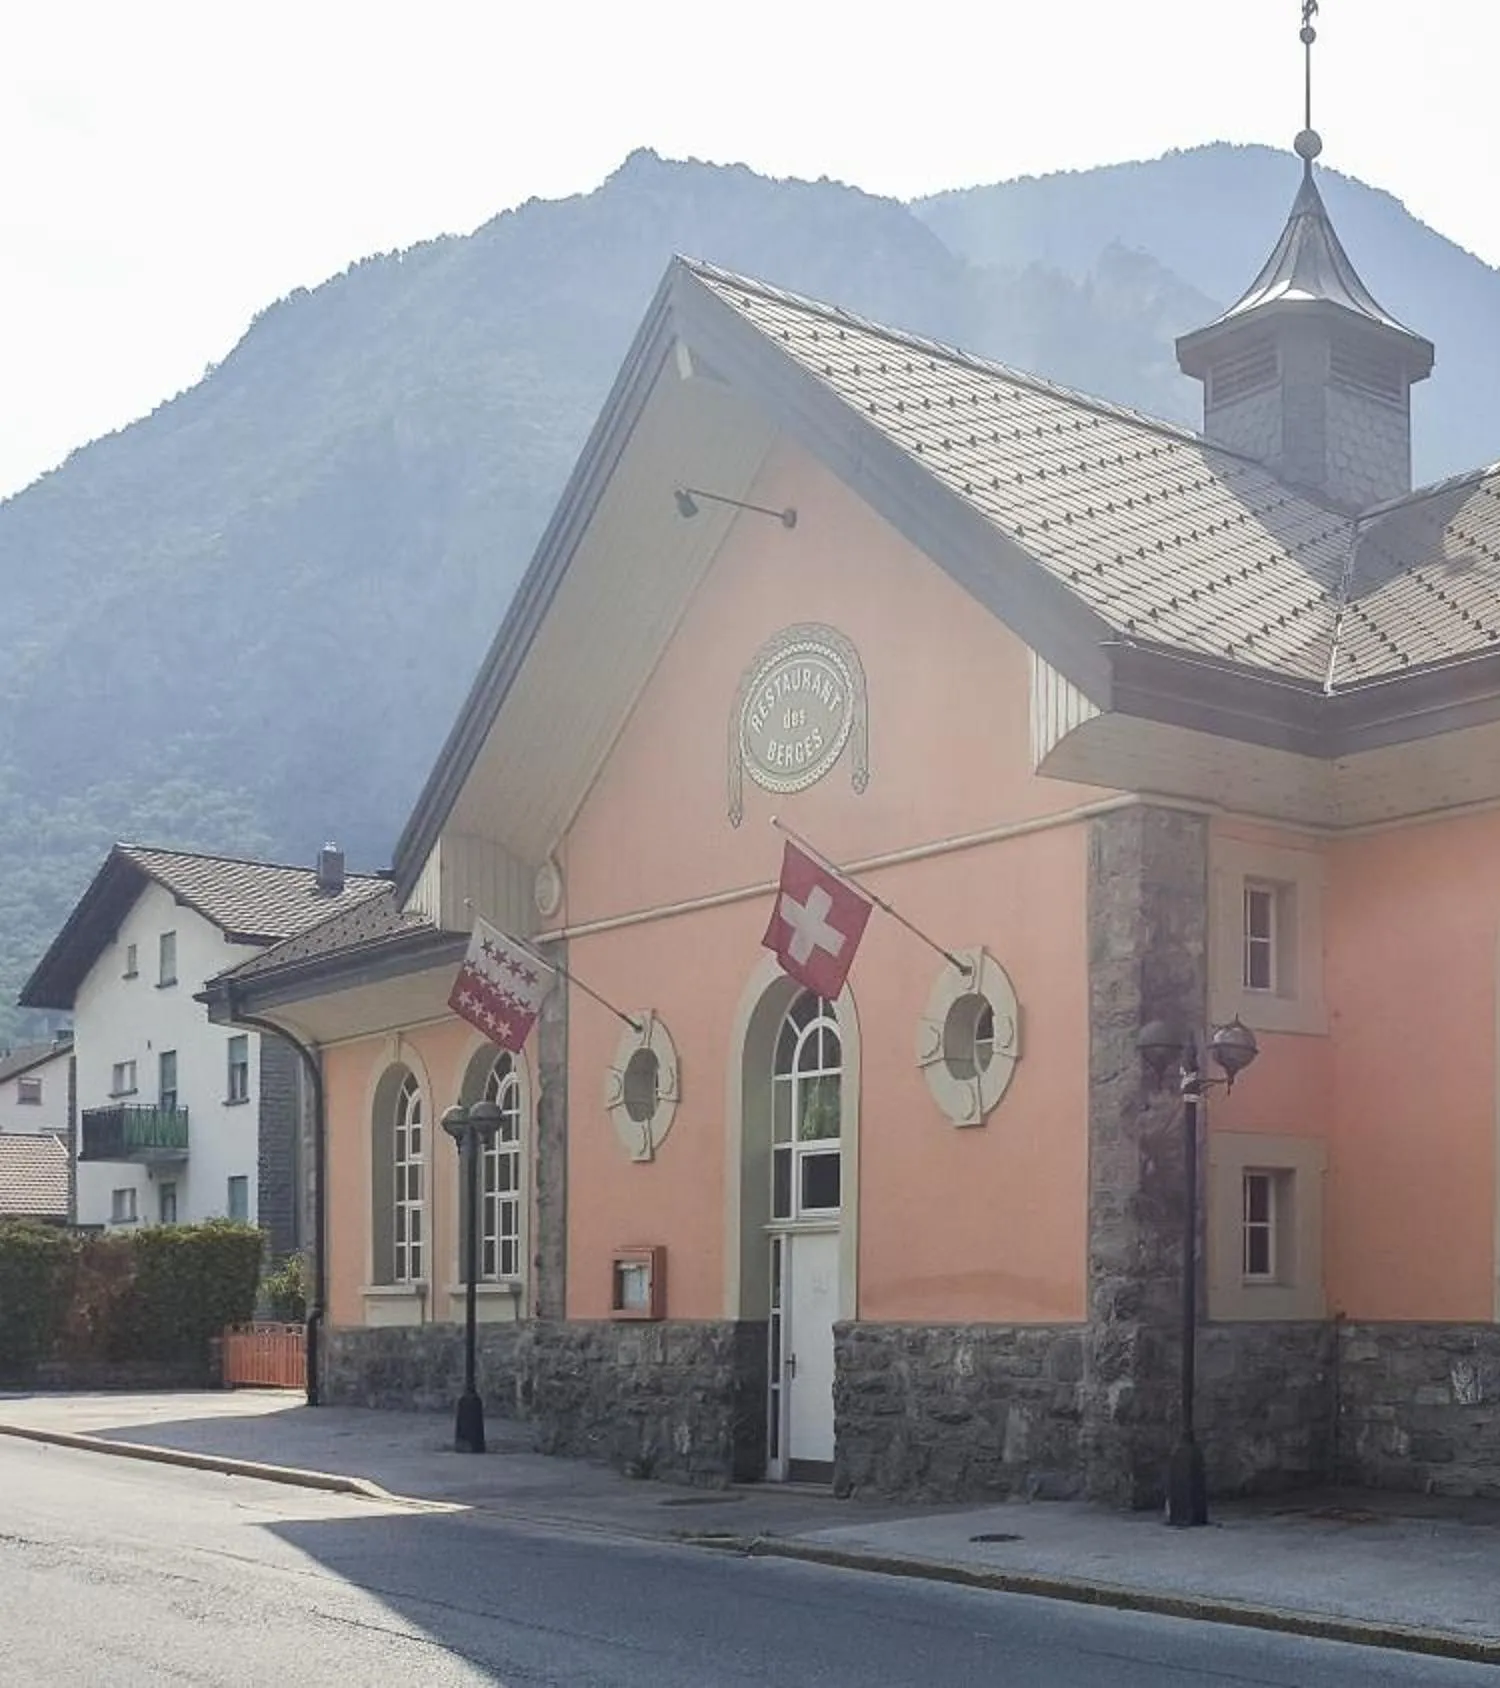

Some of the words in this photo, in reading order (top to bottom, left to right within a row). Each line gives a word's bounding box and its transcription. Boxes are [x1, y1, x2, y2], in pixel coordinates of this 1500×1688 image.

[751, 668, 842, 735] RESTAURANT
[783, 707, 805, 729] des
[767, 728, 823, 766] BERGES
